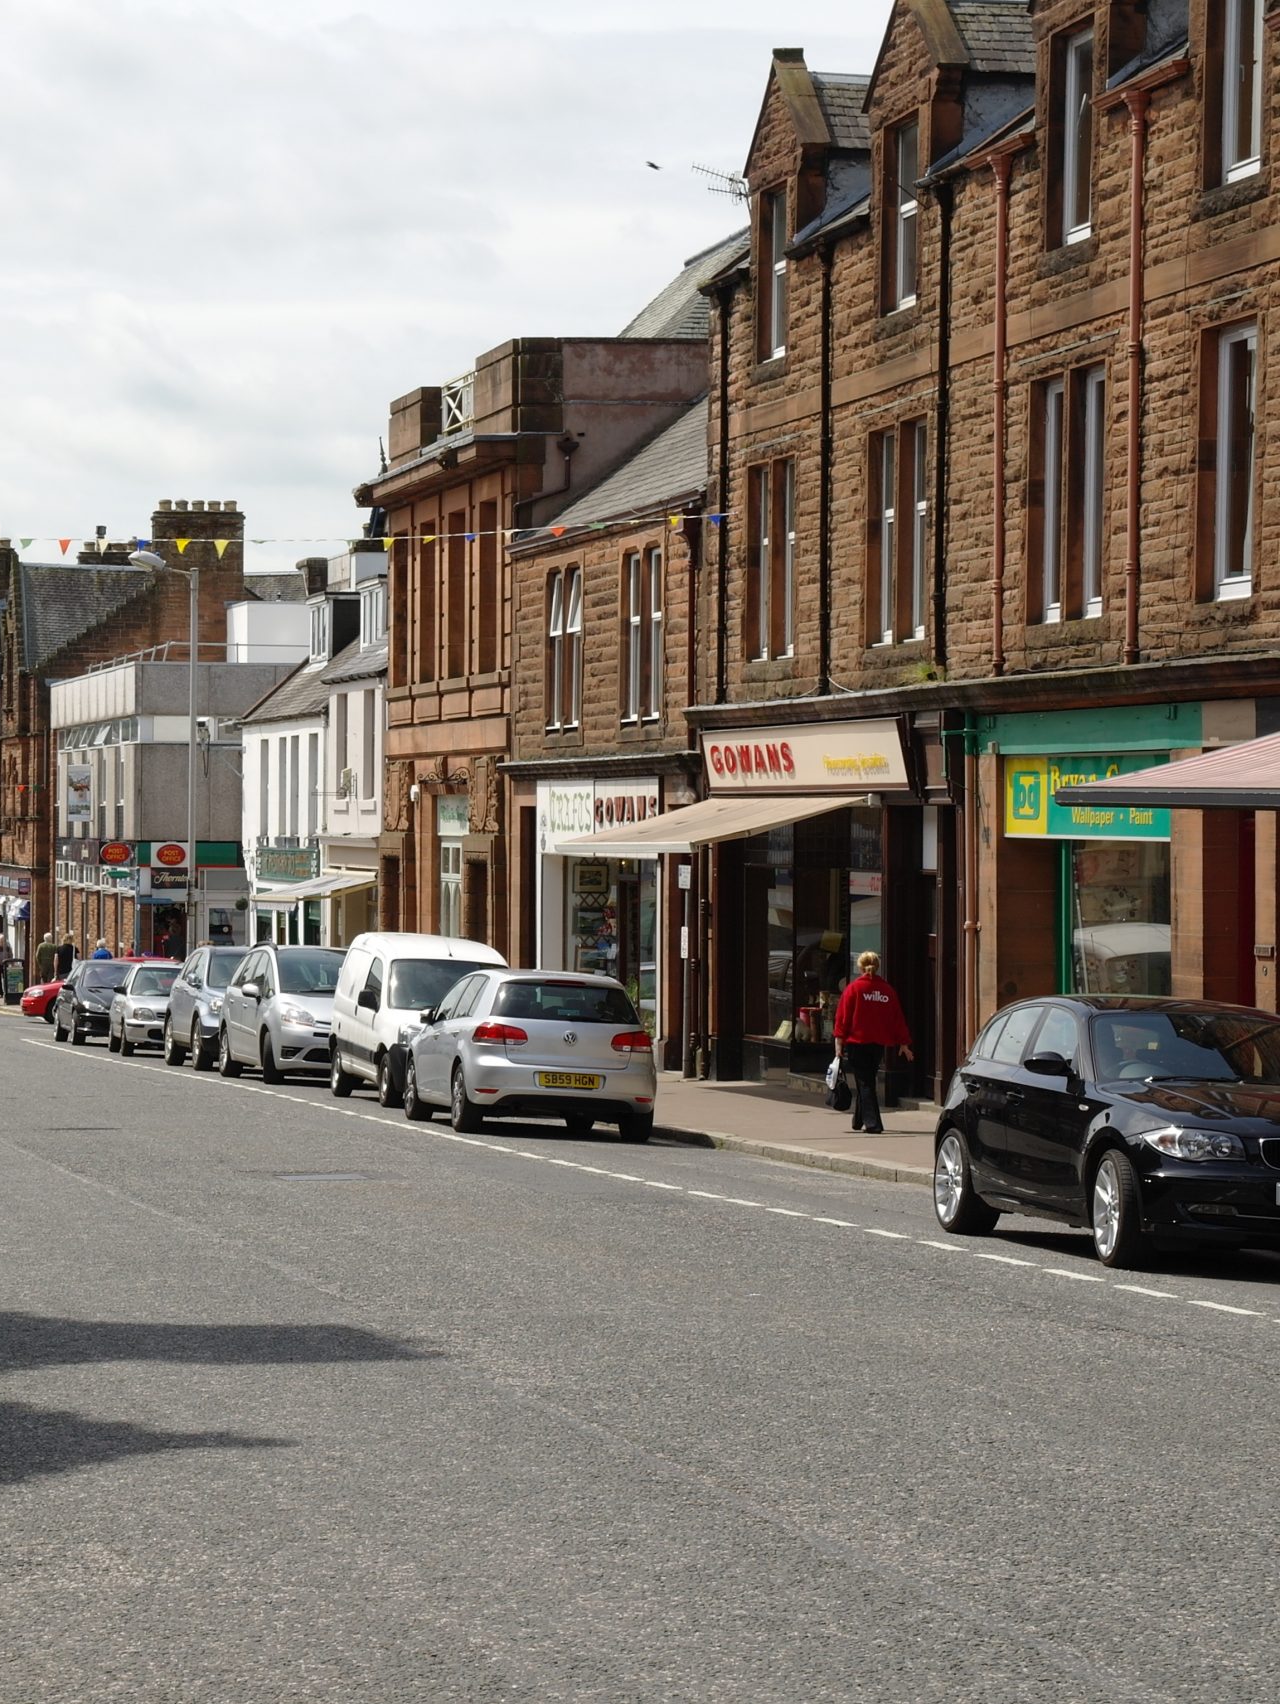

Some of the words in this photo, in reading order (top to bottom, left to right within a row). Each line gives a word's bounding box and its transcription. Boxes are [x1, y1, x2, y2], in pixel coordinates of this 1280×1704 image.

[710, 741, 795, 775] GOWANS
[594, 795, 658, 824] GOWANS
[1072, 807, 1114, 827] Wallpaper
[1129, 808, 1154, 825] Paint
[863, 991, 889, 1003] wilko
[544, 1074, 572, 1085] SB59
[574, 1075, 595, 1086] HGN
